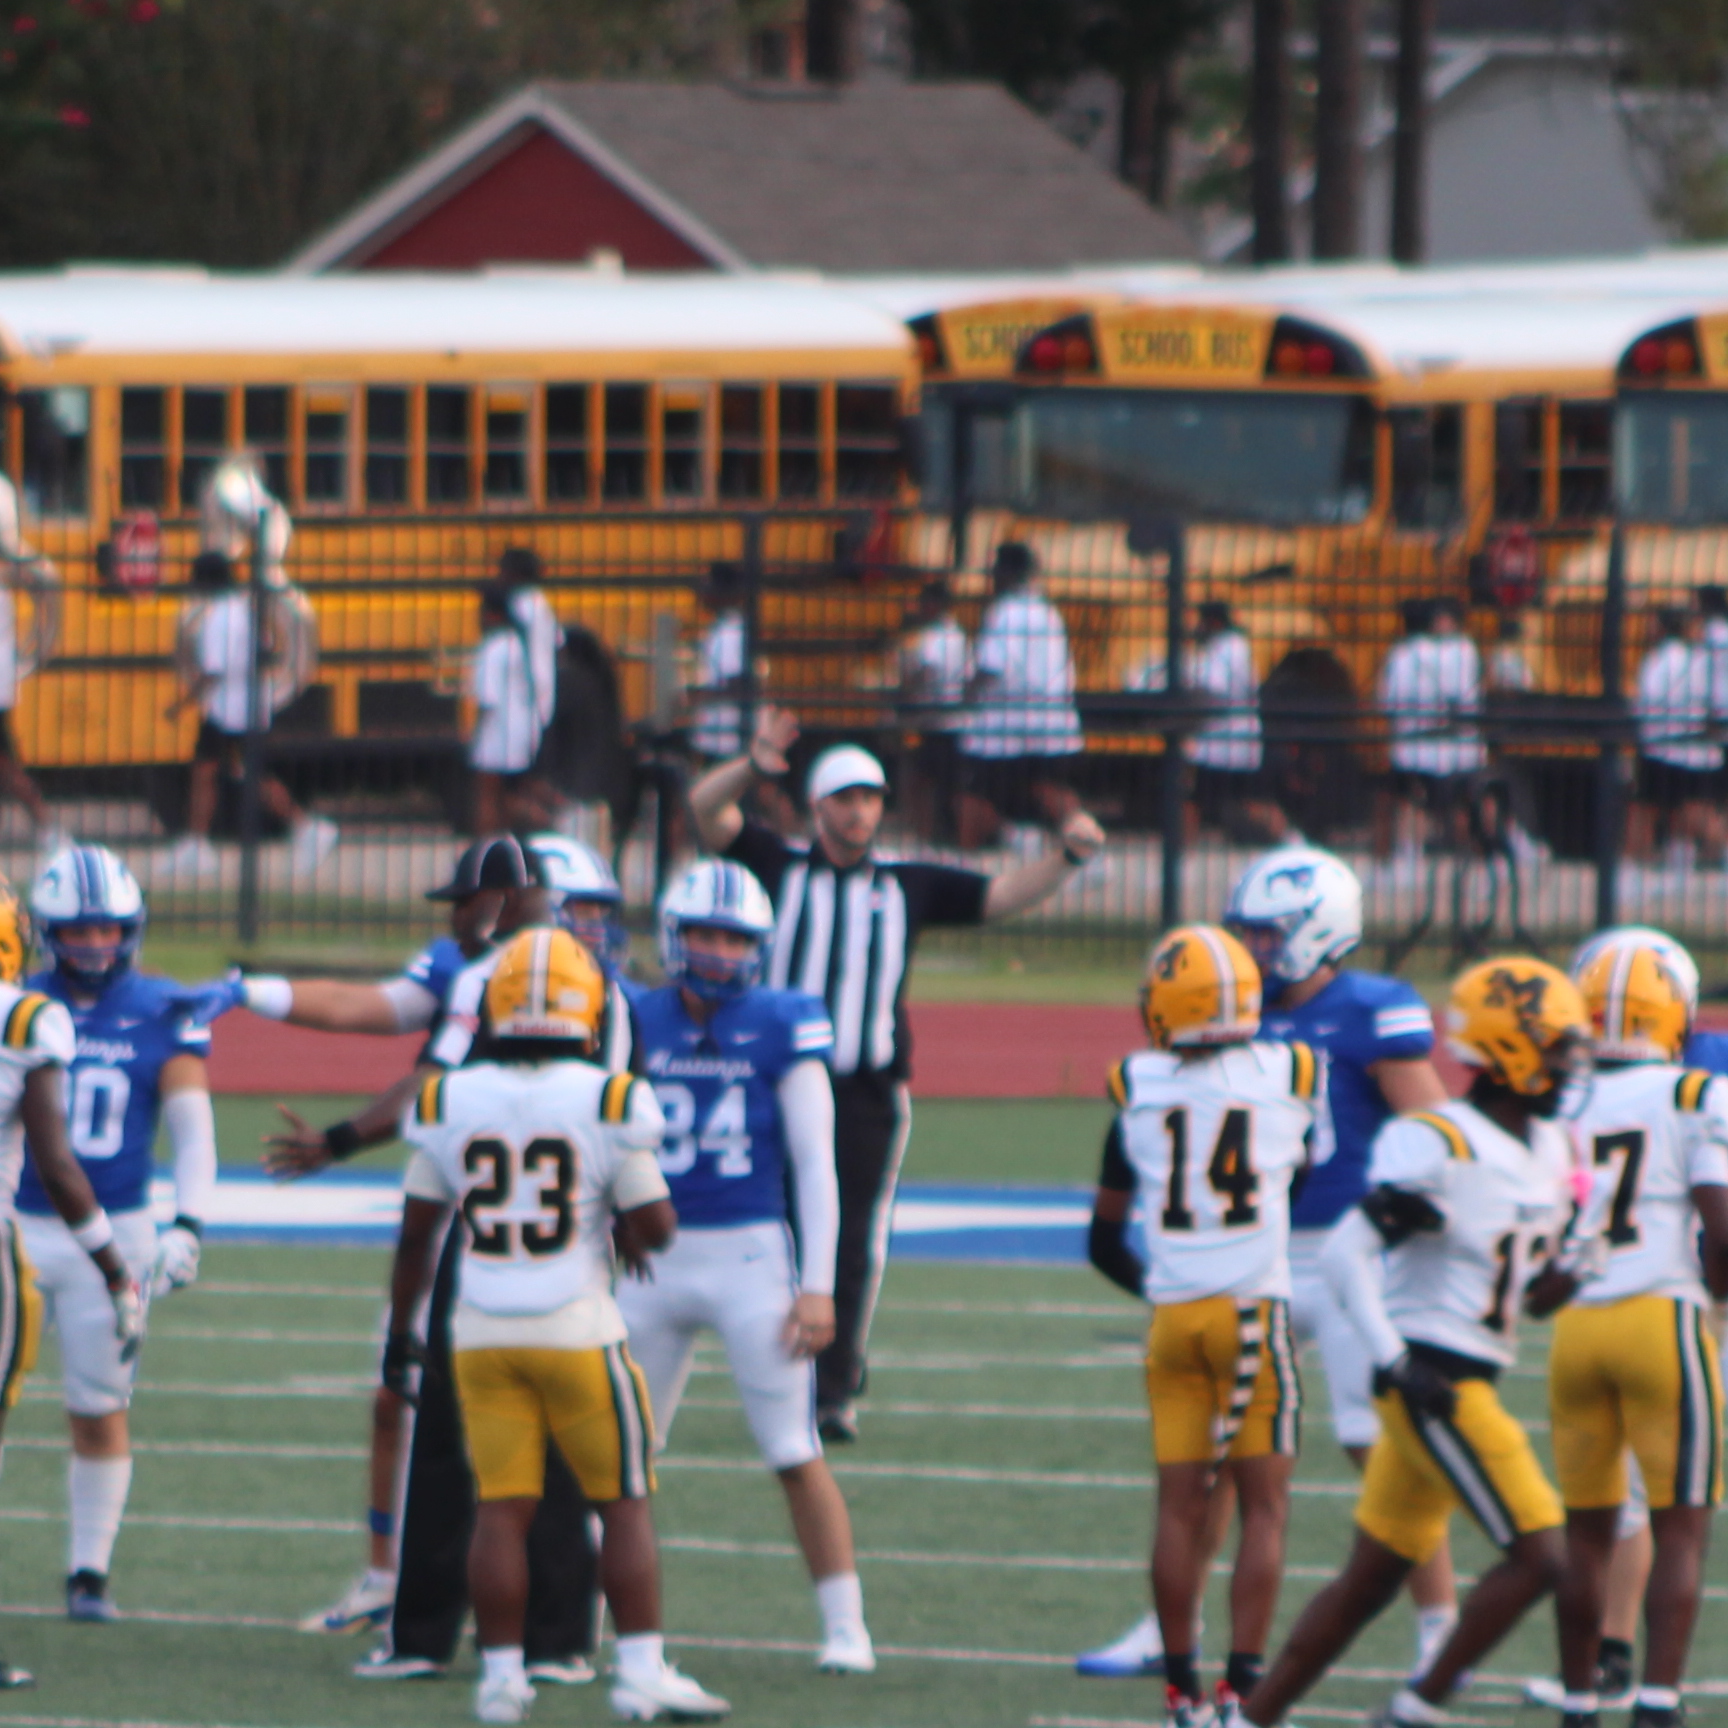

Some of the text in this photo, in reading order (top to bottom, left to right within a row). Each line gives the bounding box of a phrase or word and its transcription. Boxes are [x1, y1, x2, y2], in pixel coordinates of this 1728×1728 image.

[1120, 331, 1255, 368] SCHOOL BUS
[463, 1136, 574, 1257] 23
[1161, 1106, 1260, 1232] 14
[1593, 1130, 1648, 1247] 7
